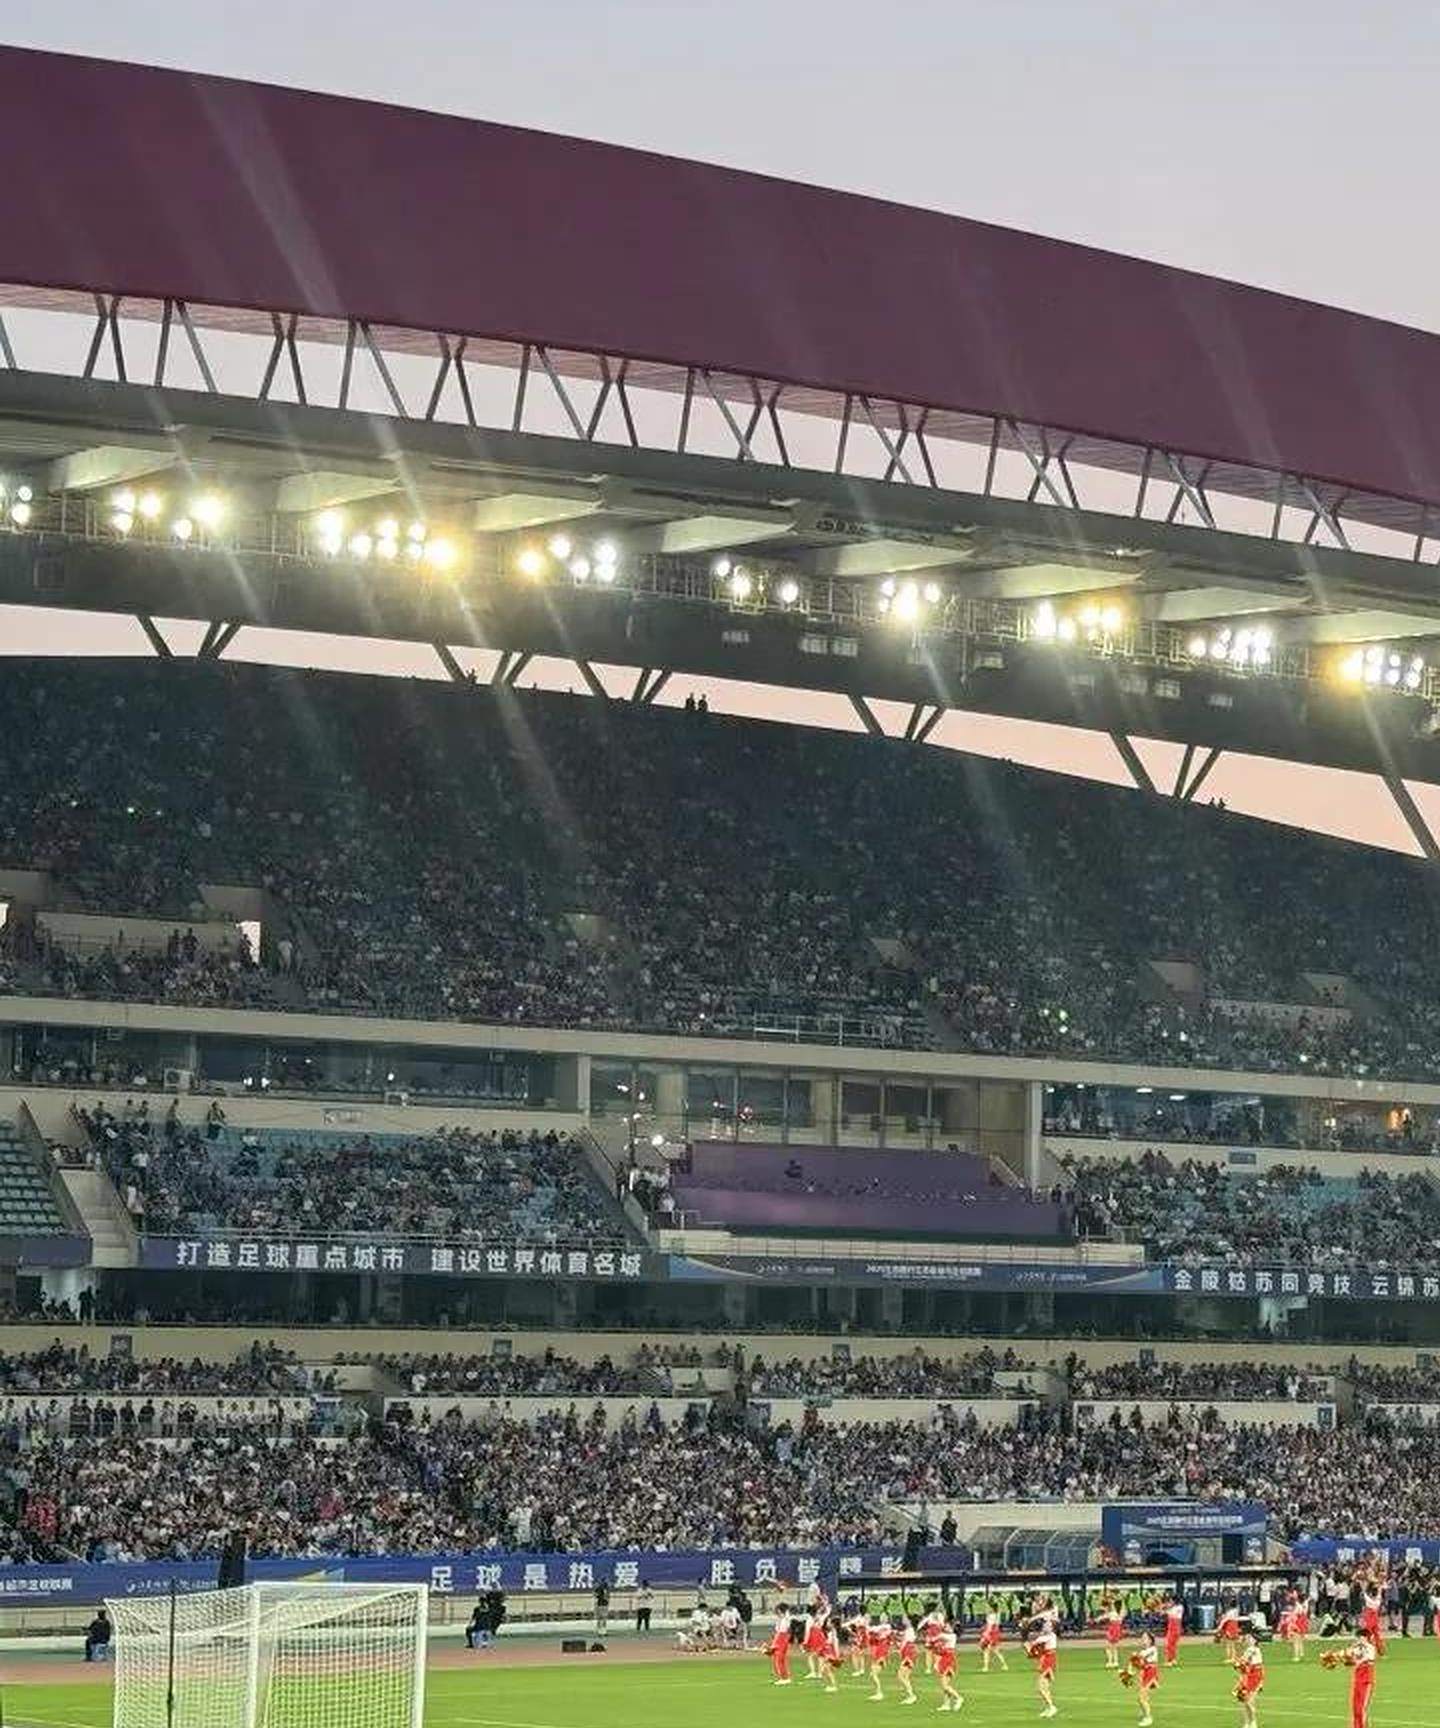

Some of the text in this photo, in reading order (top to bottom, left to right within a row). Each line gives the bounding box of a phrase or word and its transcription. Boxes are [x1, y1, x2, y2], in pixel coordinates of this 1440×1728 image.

[177, 1242, 641, 1276] 打造足球重点城市 建设世界体育名城
[1174, 1269, 1351, 1295] 金陵姑苏同竞技
[430, 1562, 639, 1593] 足球是热爱
